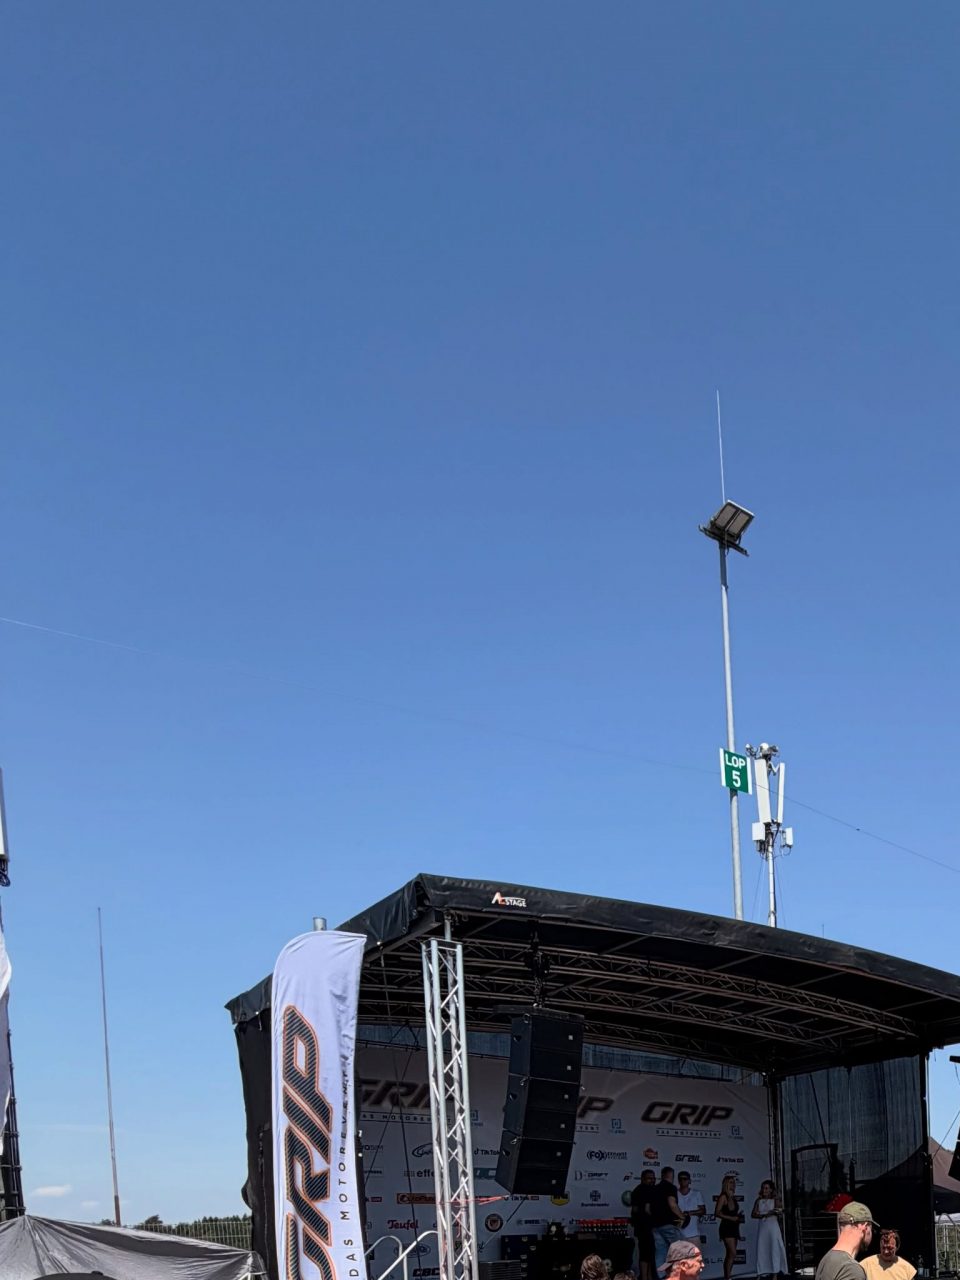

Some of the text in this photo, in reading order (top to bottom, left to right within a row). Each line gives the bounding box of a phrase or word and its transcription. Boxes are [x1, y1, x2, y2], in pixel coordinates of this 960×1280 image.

[725, 753, 746, 769] LOP
[732, 770, 741, 787] 5
[641, 1101, 734, 1127] GRIP
[387, 1219, 419, 1230] Teufel
[344, 1238, 360, 1278] DAS
